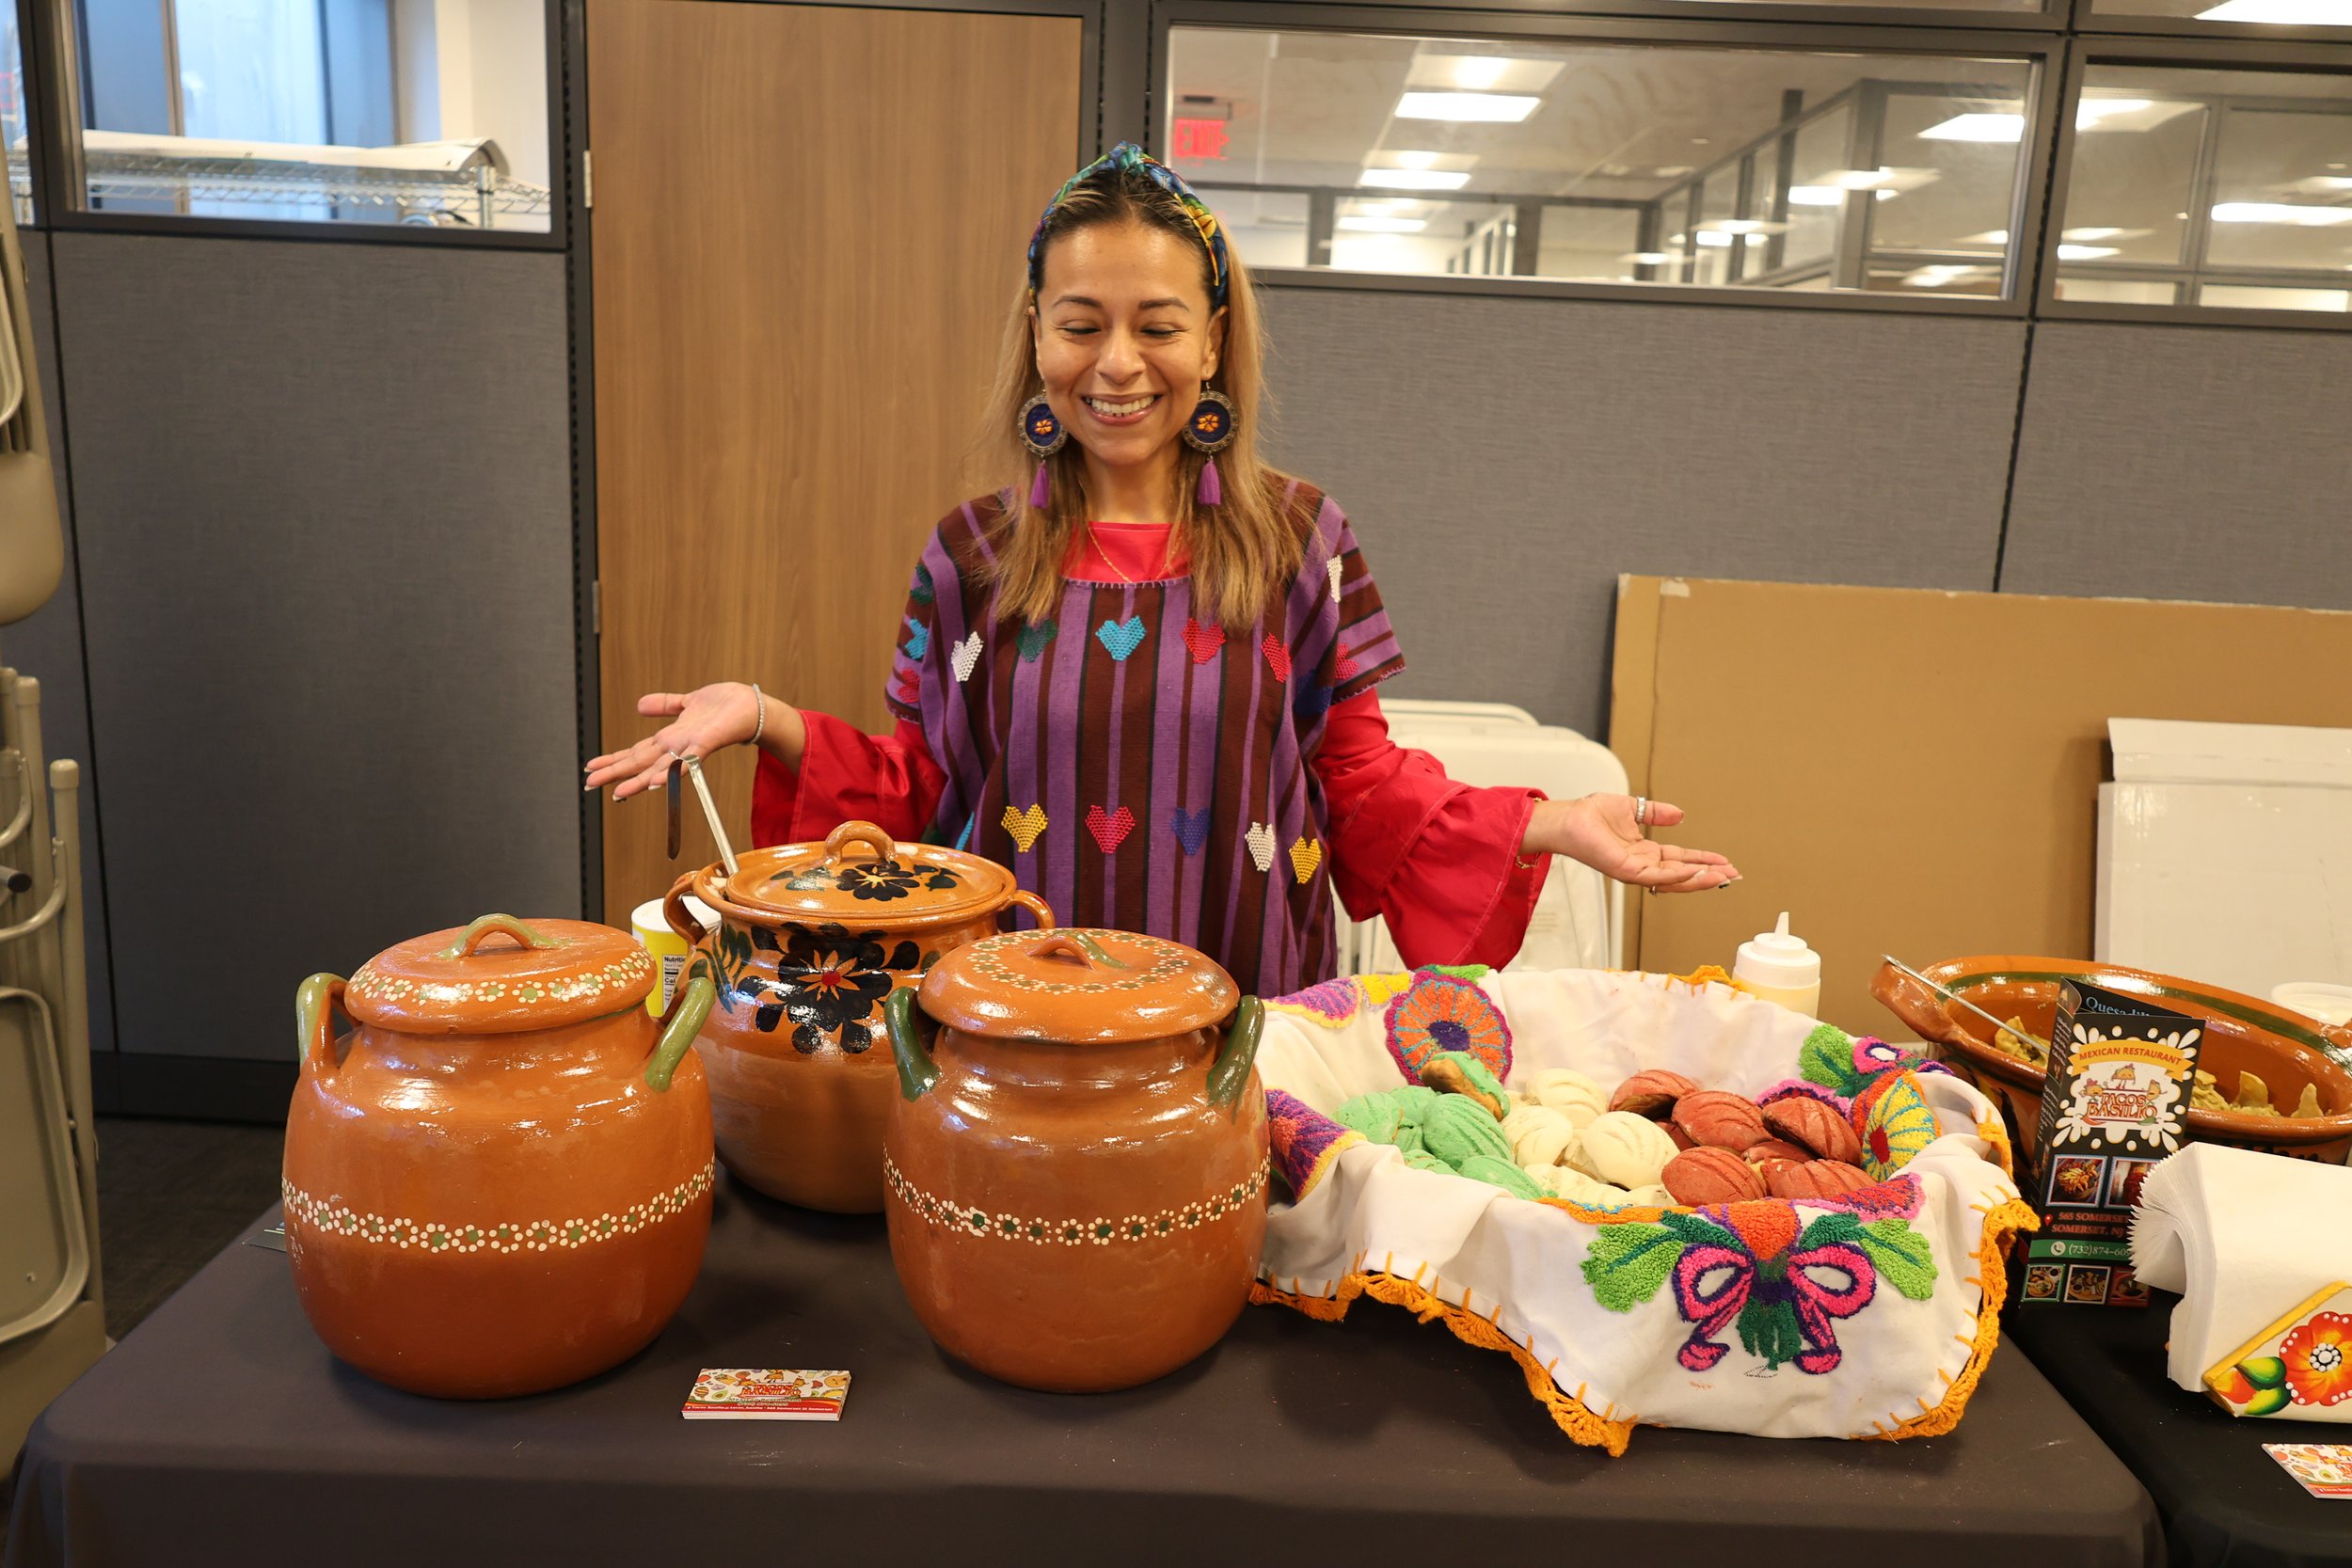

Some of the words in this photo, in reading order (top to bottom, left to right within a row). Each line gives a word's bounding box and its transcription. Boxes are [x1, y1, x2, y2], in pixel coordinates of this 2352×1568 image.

[1175, 119, 1224, 158] EXIT
[2079, 1047, 2121, 1060] MEXICAN
[2123, 1047, 2182, 1065] RESTAURANT
[2101, 1092, 2147, 1105] TACOS
[2087, 1102, 2158, 1118] BASILIO
[2058, 1212, 2074, 1221] 565
[2075, 1212, 2132, 1224] SOMERSET
[2111, 1227, 2123, 1238] NJ
